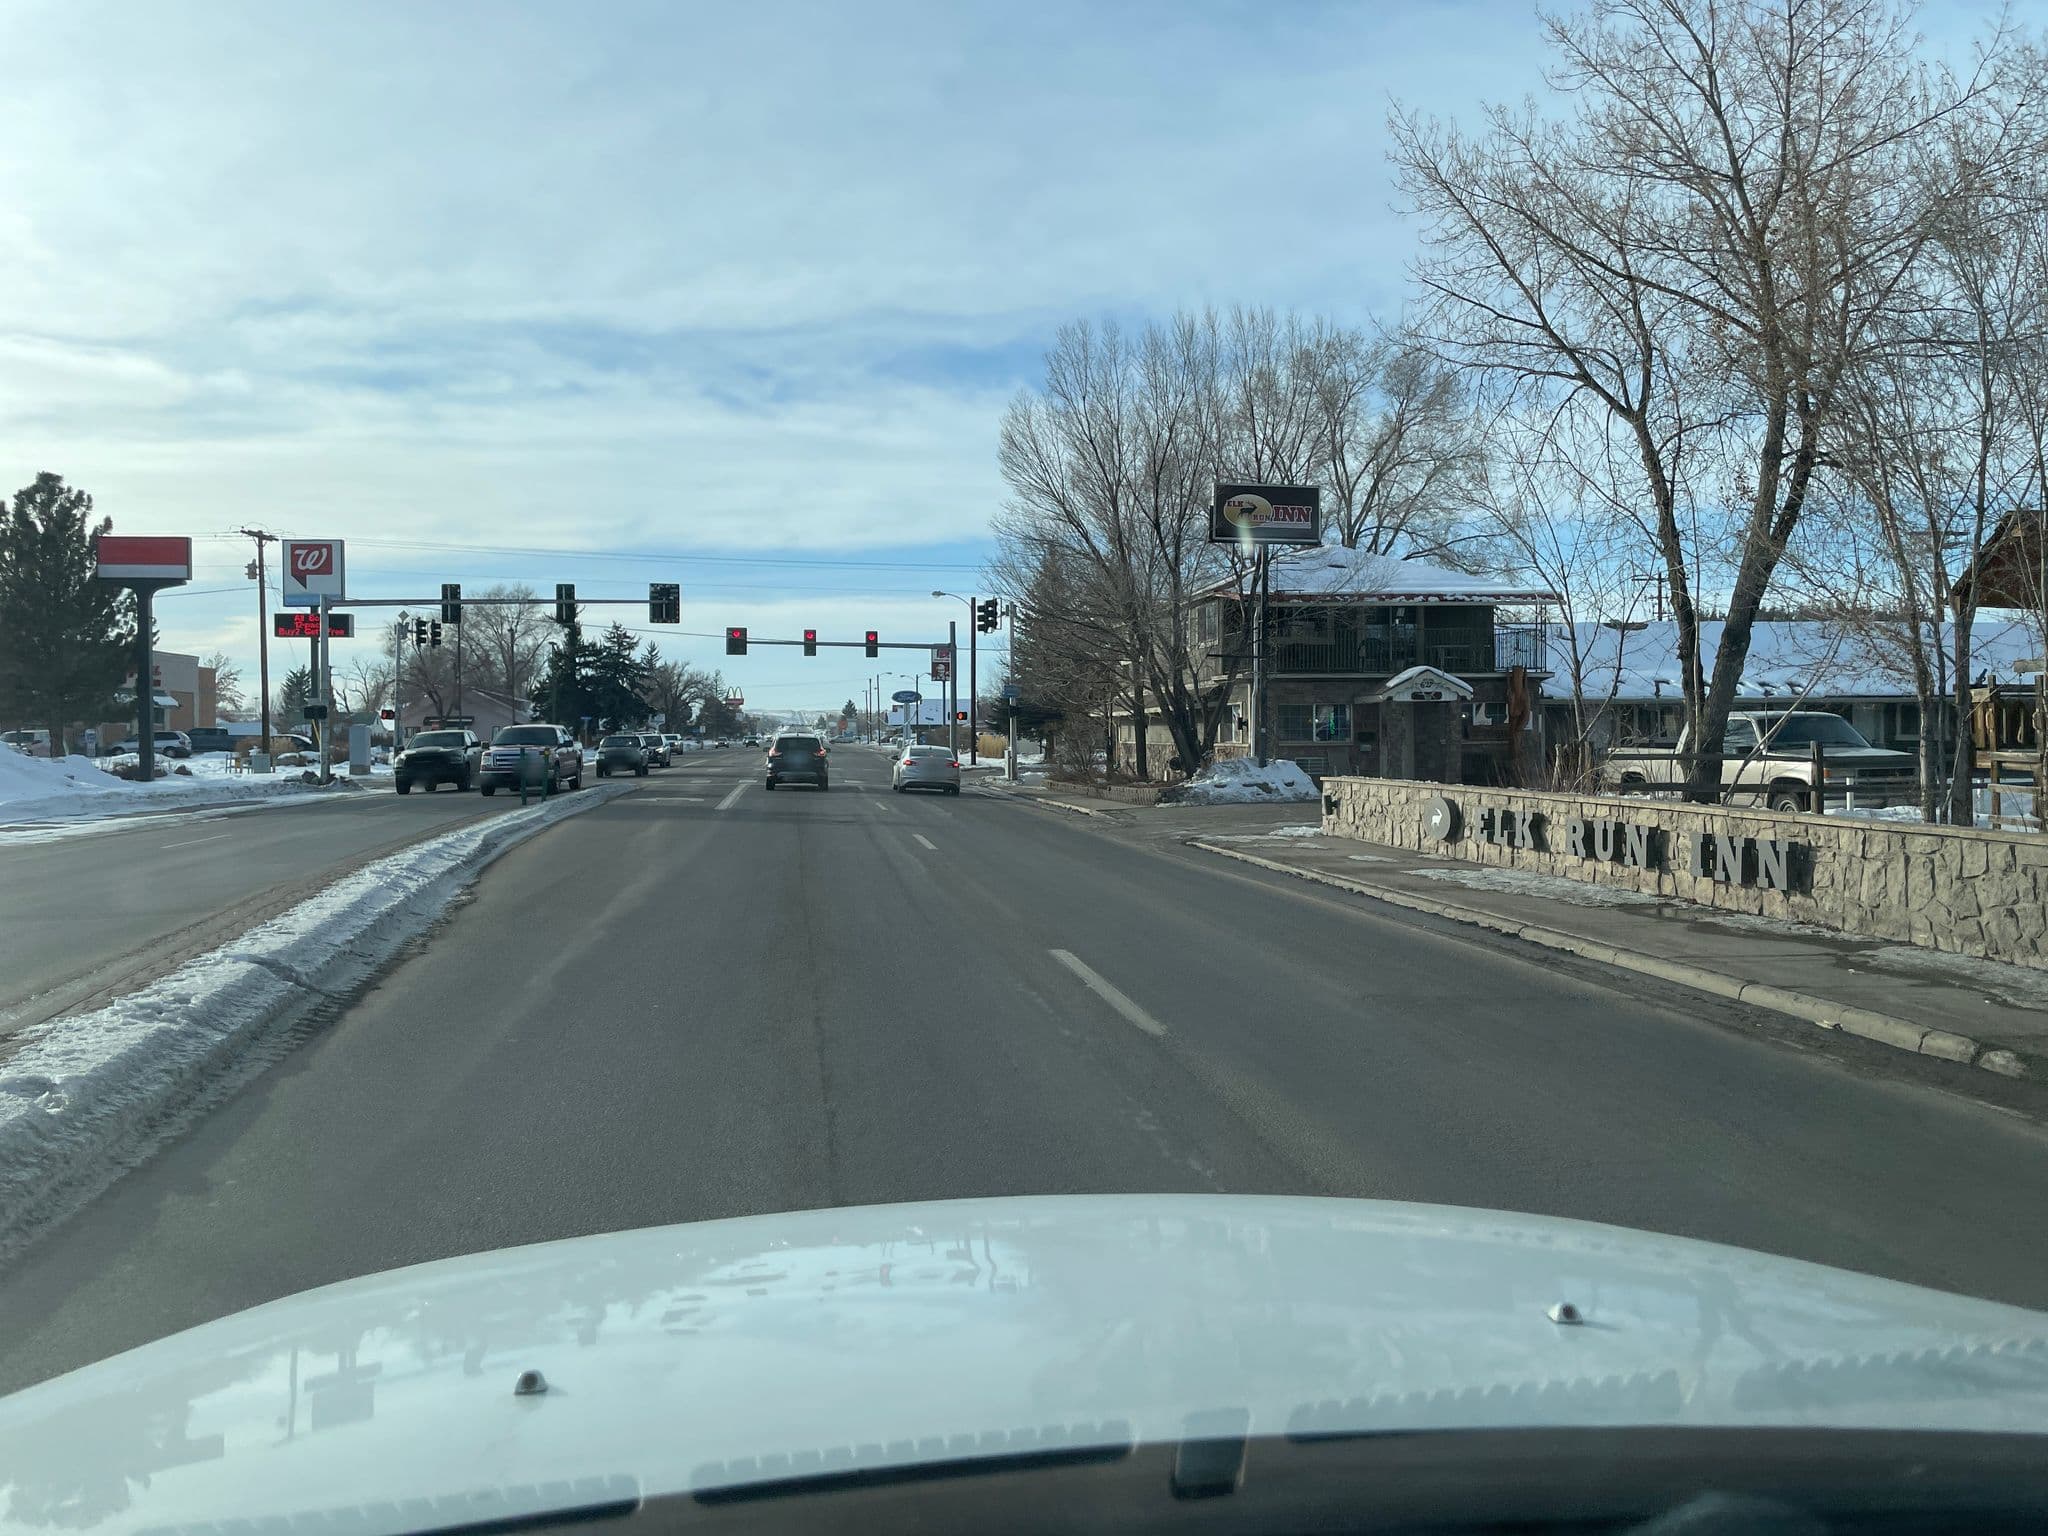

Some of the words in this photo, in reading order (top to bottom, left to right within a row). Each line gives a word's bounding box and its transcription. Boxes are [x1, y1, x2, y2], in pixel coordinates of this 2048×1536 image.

[1273, 506, 1312, 522] INN
[294, 547, 328, 570] W
[1474, 807, 1534, 849] ELK
[1566, 816, 1649, 869] RUN
[1690, 831, 1789, 891] INN
